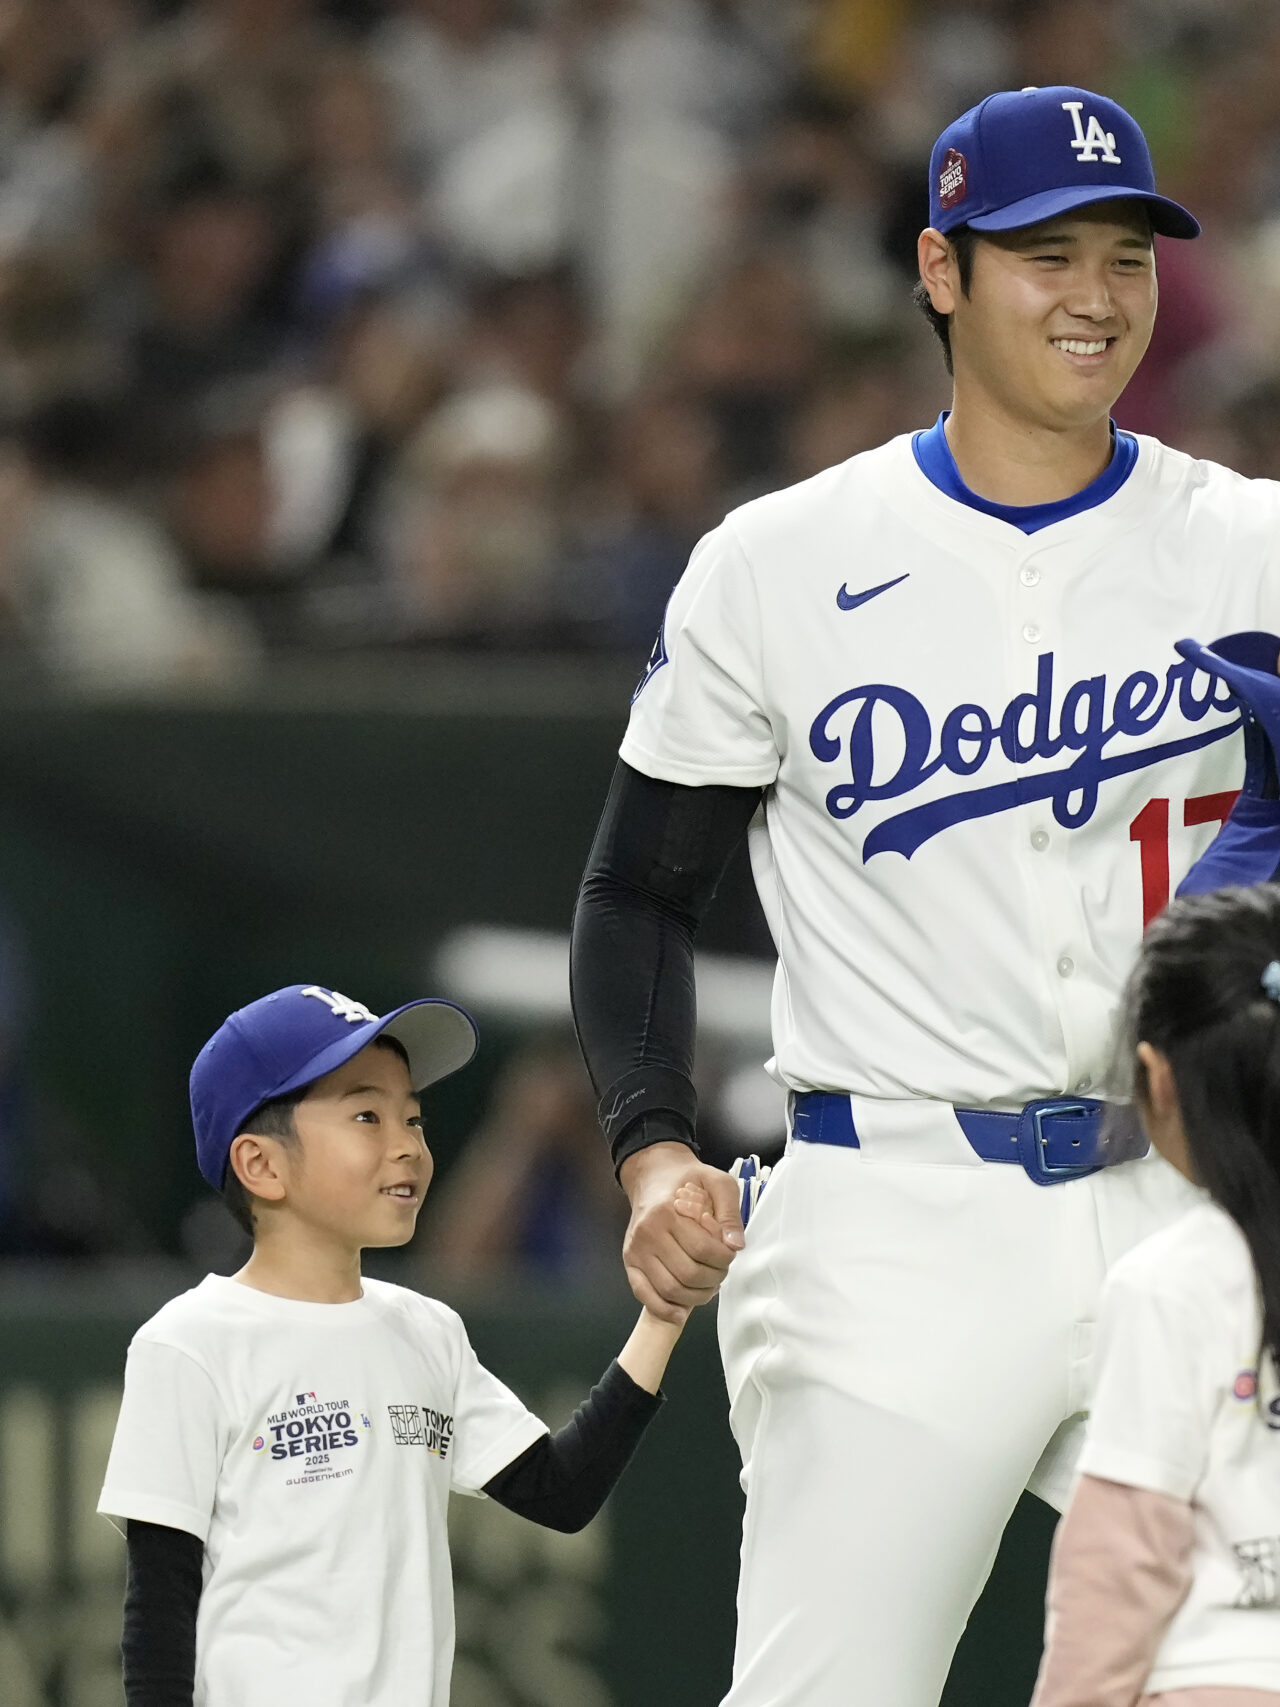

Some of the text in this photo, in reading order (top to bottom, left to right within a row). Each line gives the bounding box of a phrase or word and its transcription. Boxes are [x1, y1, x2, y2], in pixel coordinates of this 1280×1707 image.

[1062, 102, 1121, 164] LA
[939, 174, 963, 197] SERIES
[940, 165, 962, 188] TOKYO
[301, 986, 379, 1022] LA
[267, 1400, 350, 1425] MLB WORLD TOUR
[270, 1411, 352, 1442] TOKYO
[271, 1429, 359, 1460] SERIES
[424, 1427, 450, 1456] UNE
[305, 1454, 330, 1466] 2025
[286, 1468, 354, 1486] GUGGENHEIM
